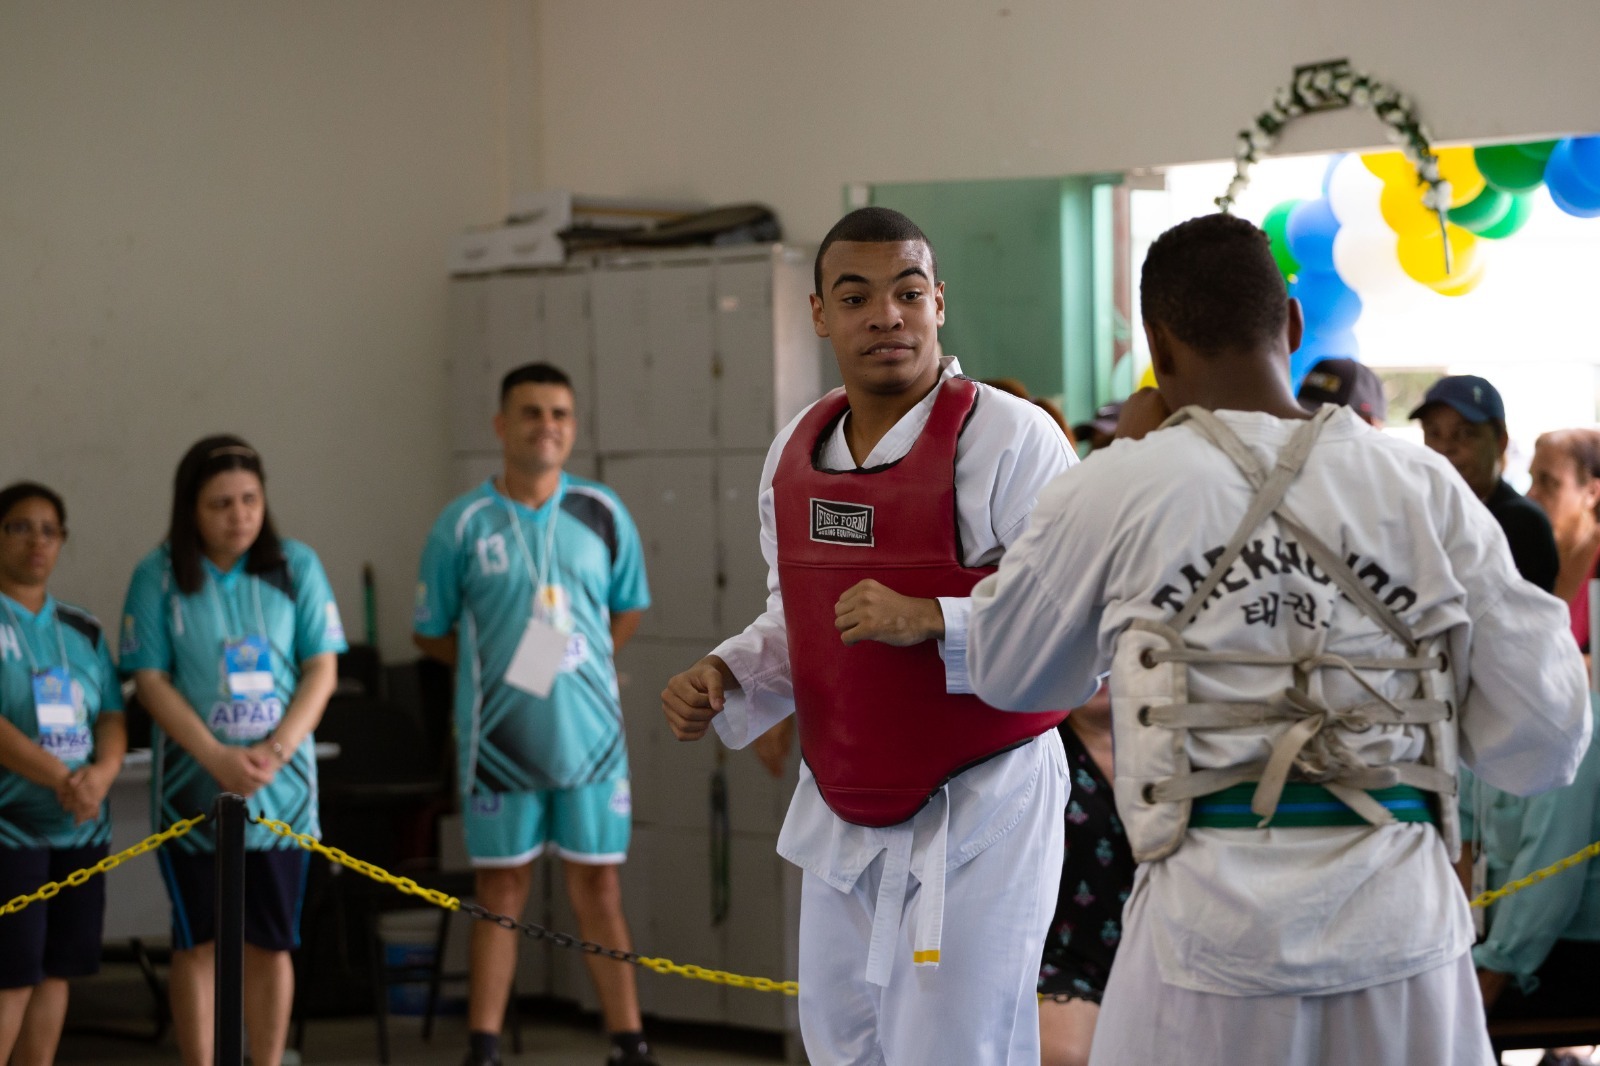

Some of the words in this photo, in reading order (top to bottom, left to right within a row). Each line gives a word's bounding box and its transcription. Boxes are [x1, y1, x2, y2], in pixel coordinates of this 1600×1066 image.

[818, 509, 839, 526] FISIC
[841, 515, 867, 533] FORM
[477, 533, 509, 576] 13
